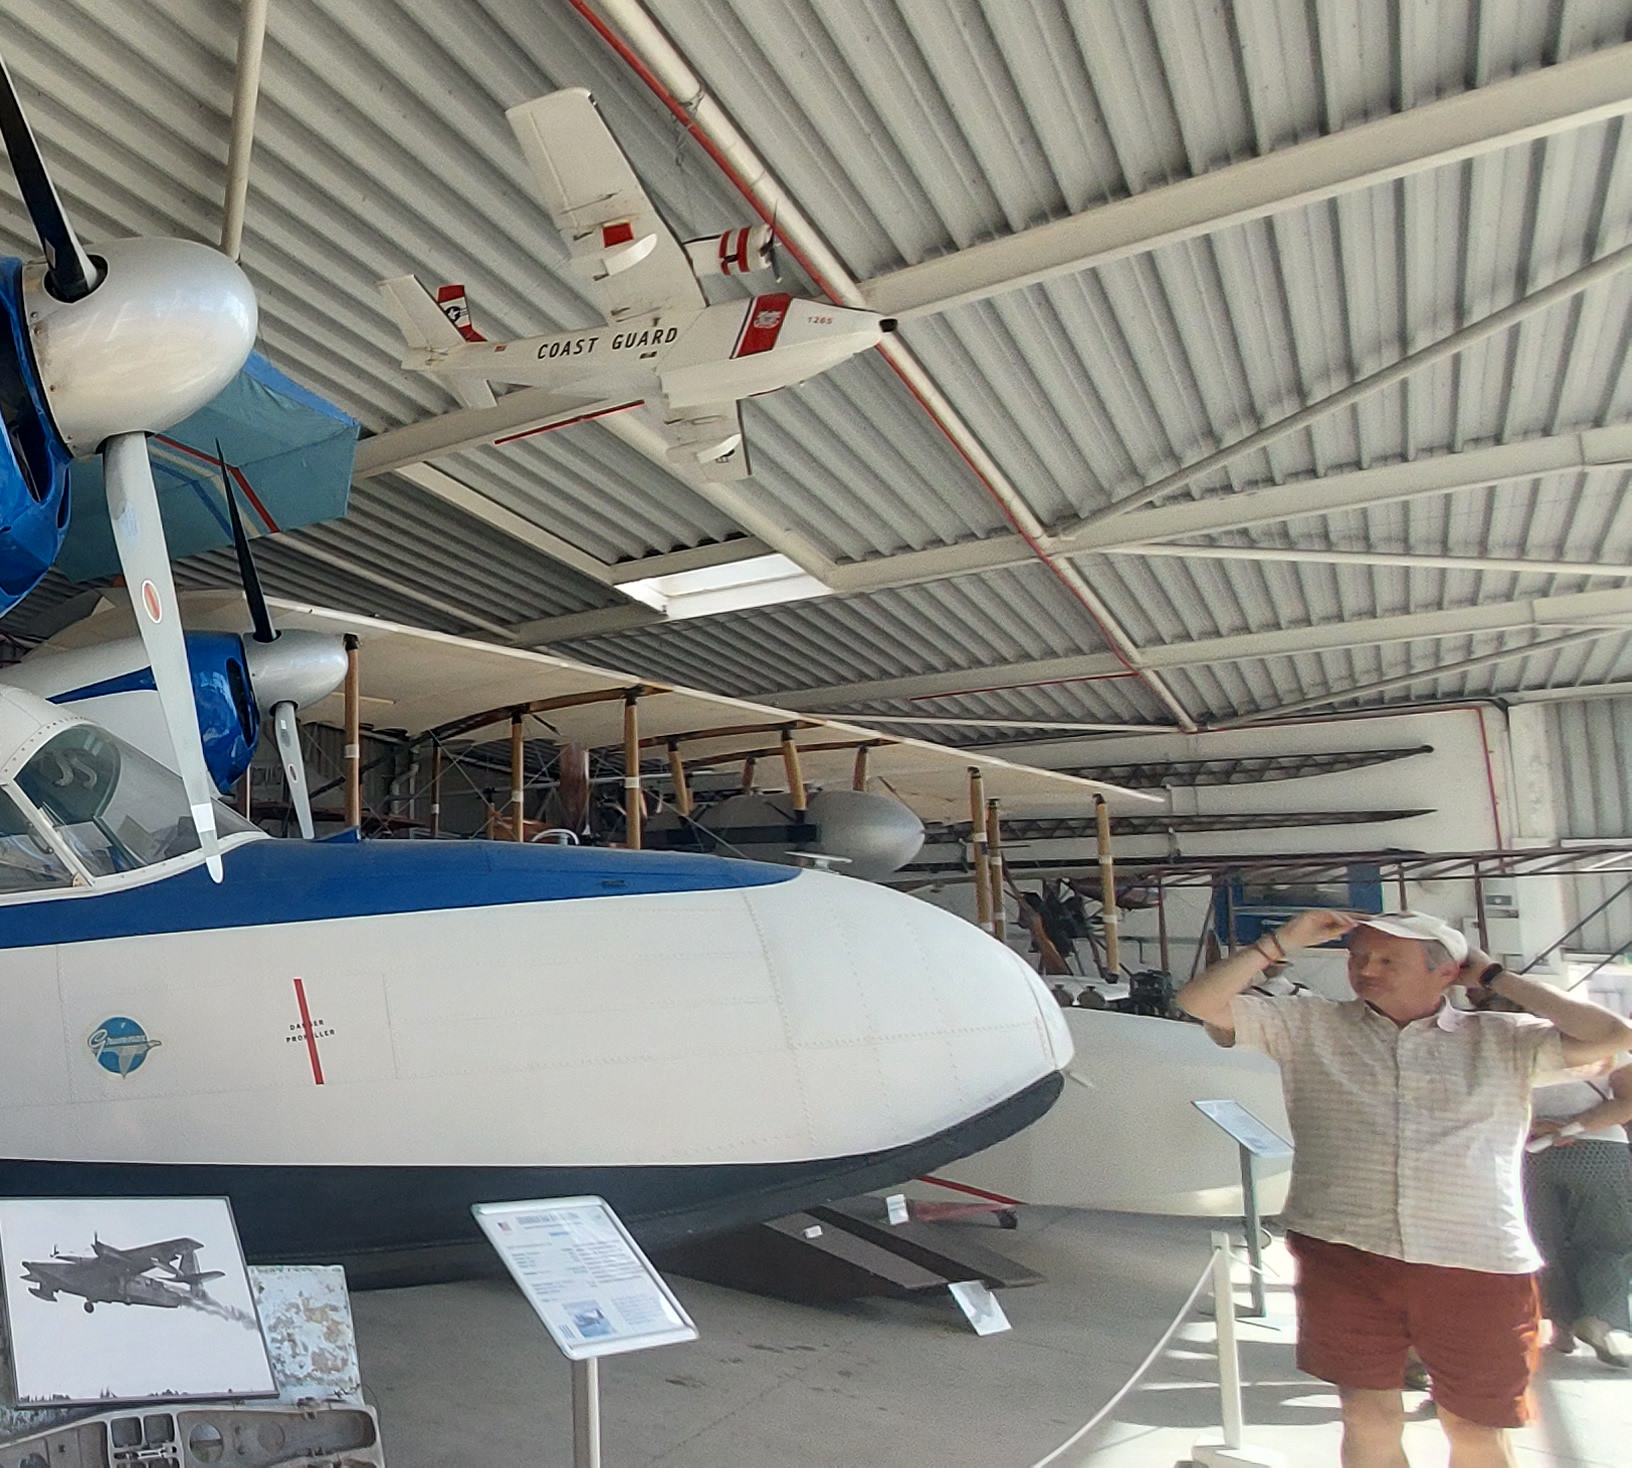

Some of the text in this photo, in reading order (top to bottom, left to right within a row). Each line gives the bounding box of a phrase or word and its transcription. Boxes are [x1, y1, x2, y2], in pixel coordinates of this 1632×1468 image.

[537, 327, 678, 360] COAST GUARD
[286, 1029, 335, 1043] PROLLER
